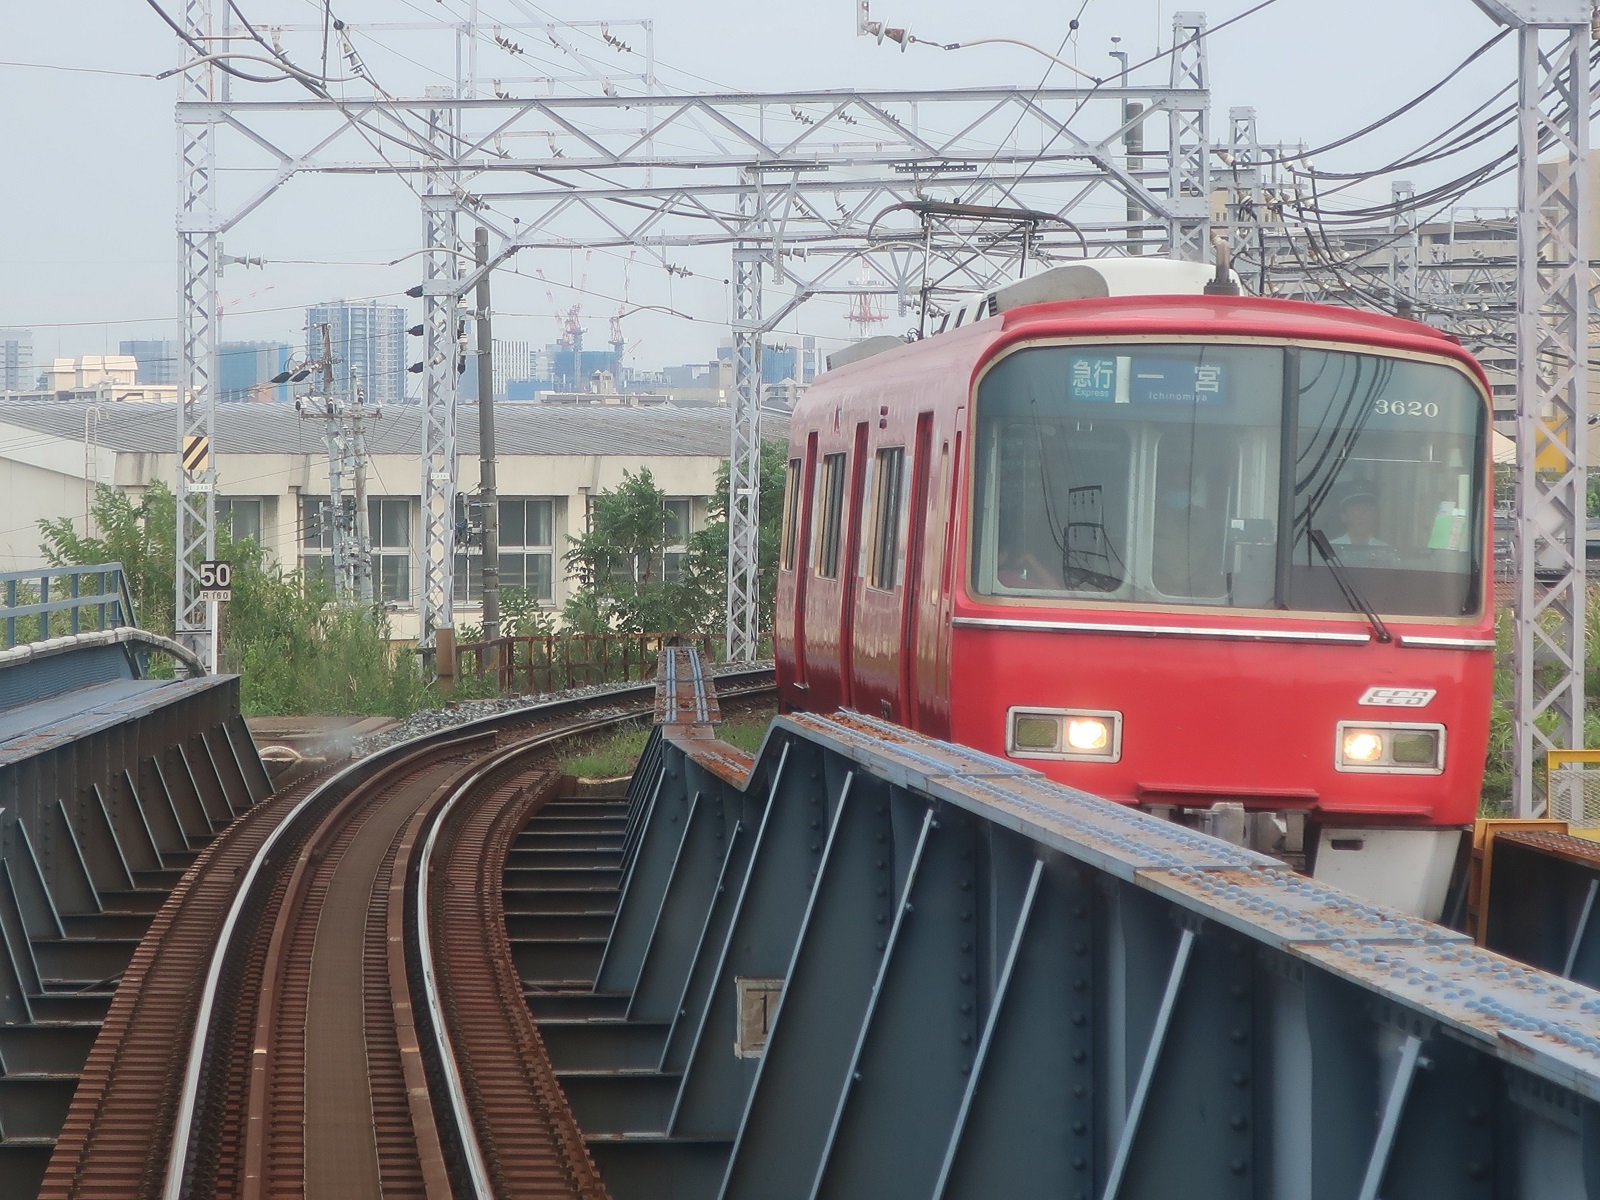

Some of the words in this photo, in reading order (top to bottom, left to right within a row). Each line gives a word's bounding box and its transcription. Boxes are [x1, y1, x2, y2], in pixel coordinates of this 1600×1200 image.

[1073, 360, 1113, 388] 急行
[1137, 365, 1221, 392] 一宮
[1075, 388, 1109, 398] Express
[1149, 391, 1208, 402] Ichinomiya
[1375, 400, 1438, 418] 3620
[201, 564, 230, 586] 50
